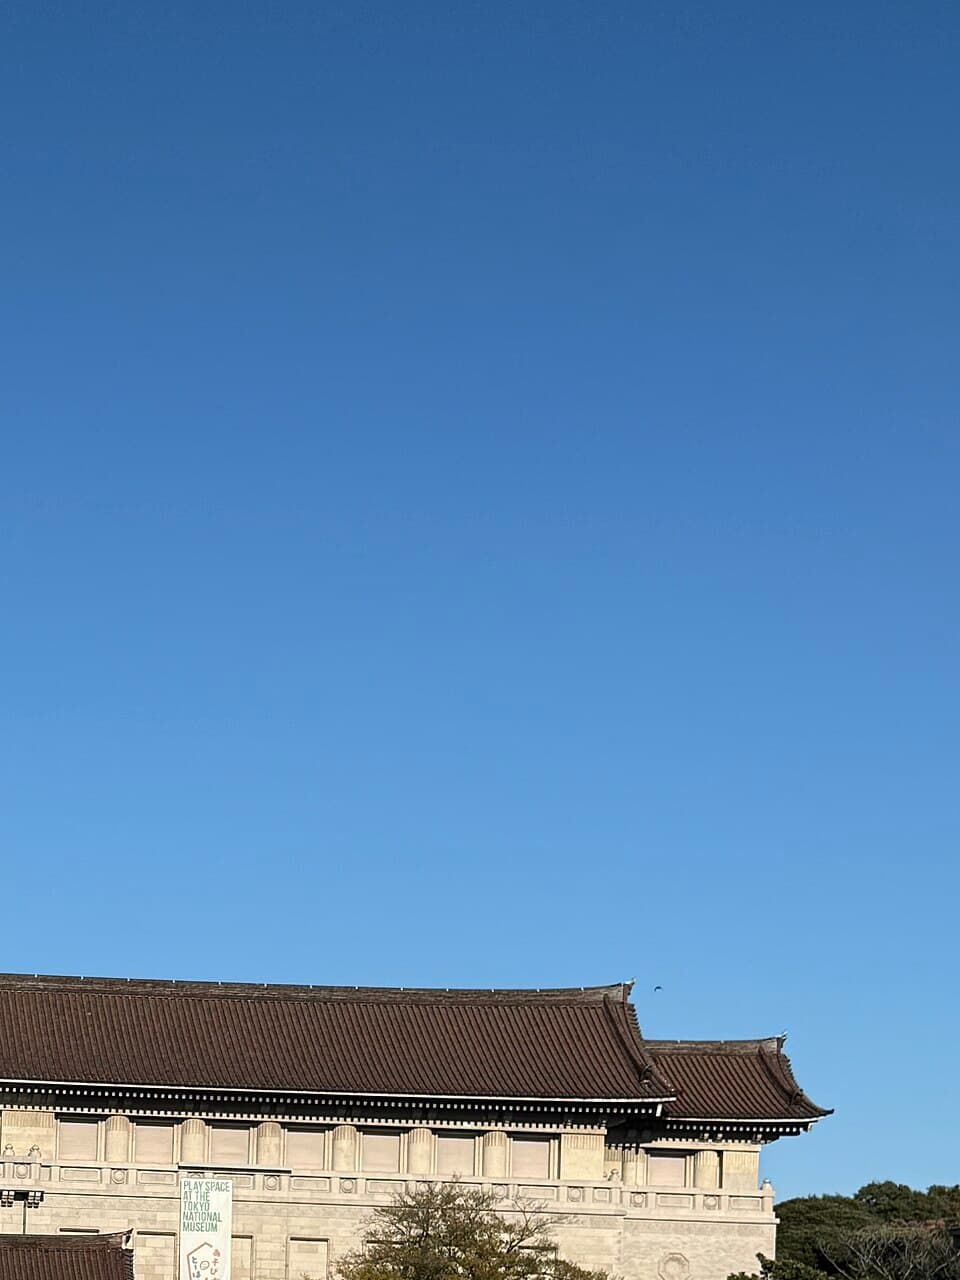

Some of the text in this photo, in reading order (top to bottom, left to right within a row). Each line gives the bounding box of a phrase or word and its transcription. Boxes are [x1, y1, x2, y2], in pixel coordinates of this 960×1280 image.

[183, 1180, 230, 1192] PLAY SPACE
[183, 1190, 211, 1202] AT THE
[183, 1201, 210, 1212] TOKYO
[182, 1211, 222, 1222] NATIONAL
[182, 1221, 218, 1233] MUSEUM
